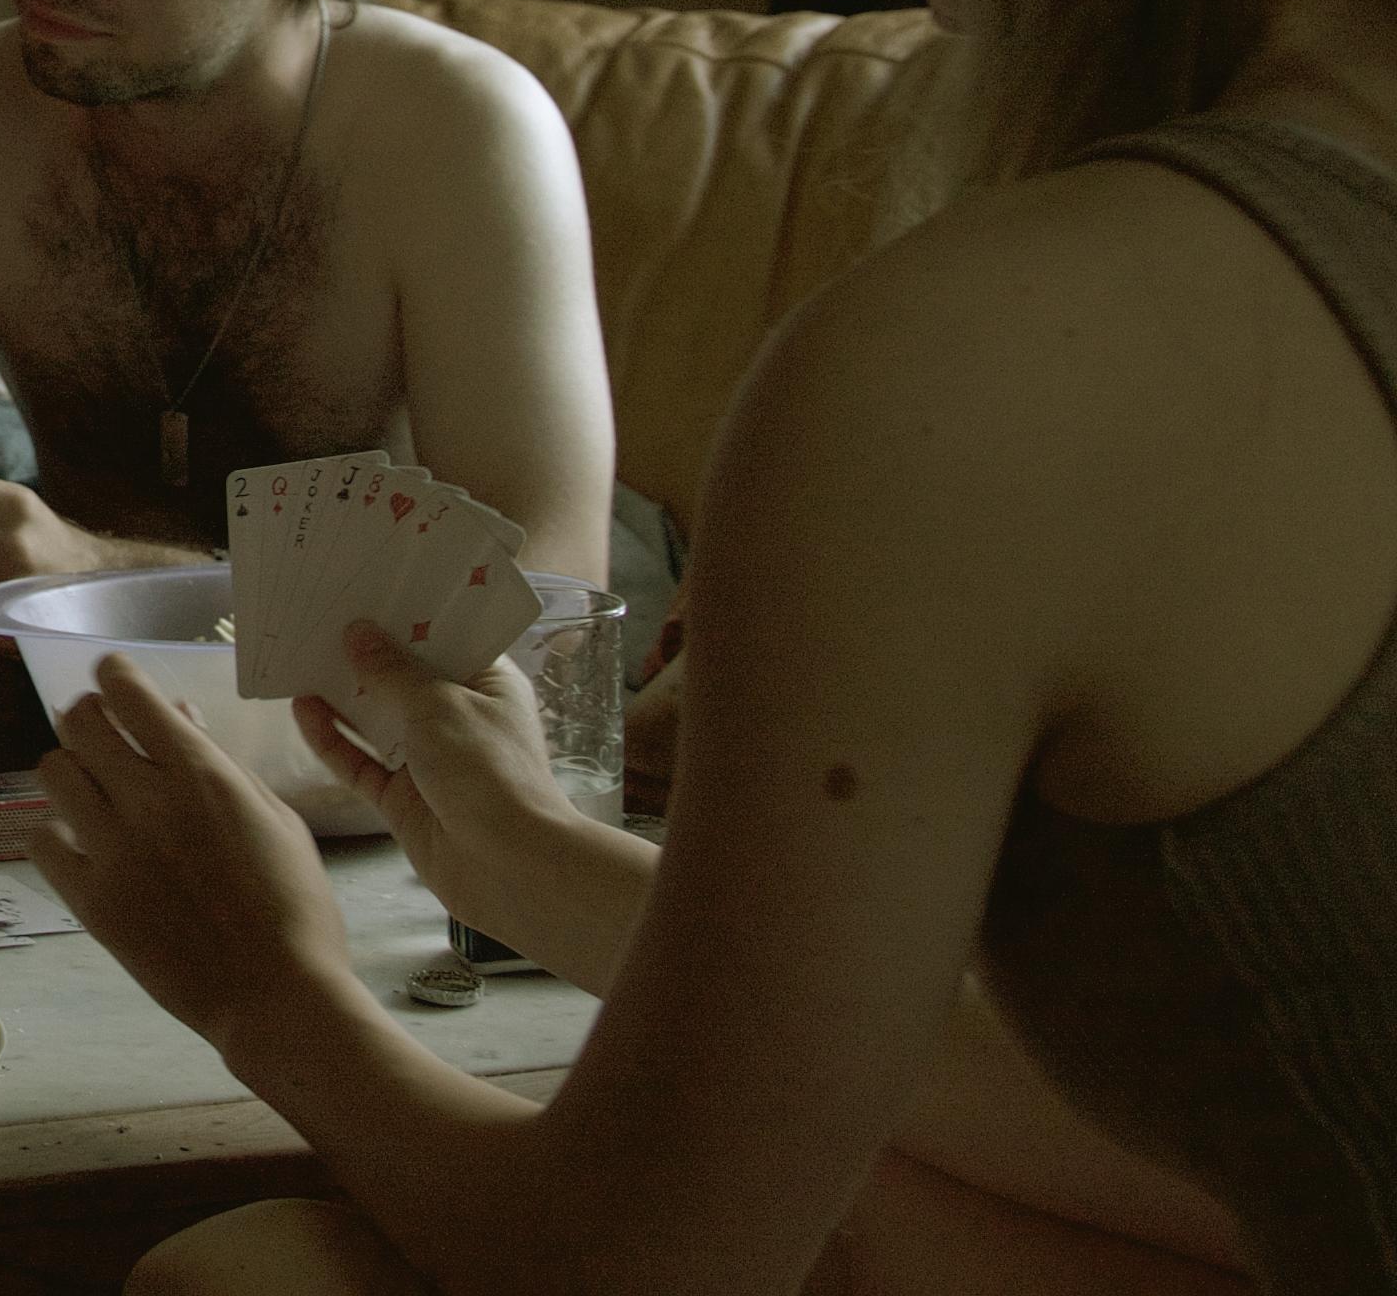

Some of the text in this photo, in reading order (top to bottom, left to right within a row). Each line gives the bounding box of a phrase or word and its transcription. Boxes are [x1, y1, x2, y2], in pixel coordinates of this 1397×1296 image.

[272, 476, 287, 496] Q
[342, 466, 361, 486] J
[368, 473, 385, 494] 8
[234, 477, 250, 498] 2
[294, 468, 322, 549] JOKER
